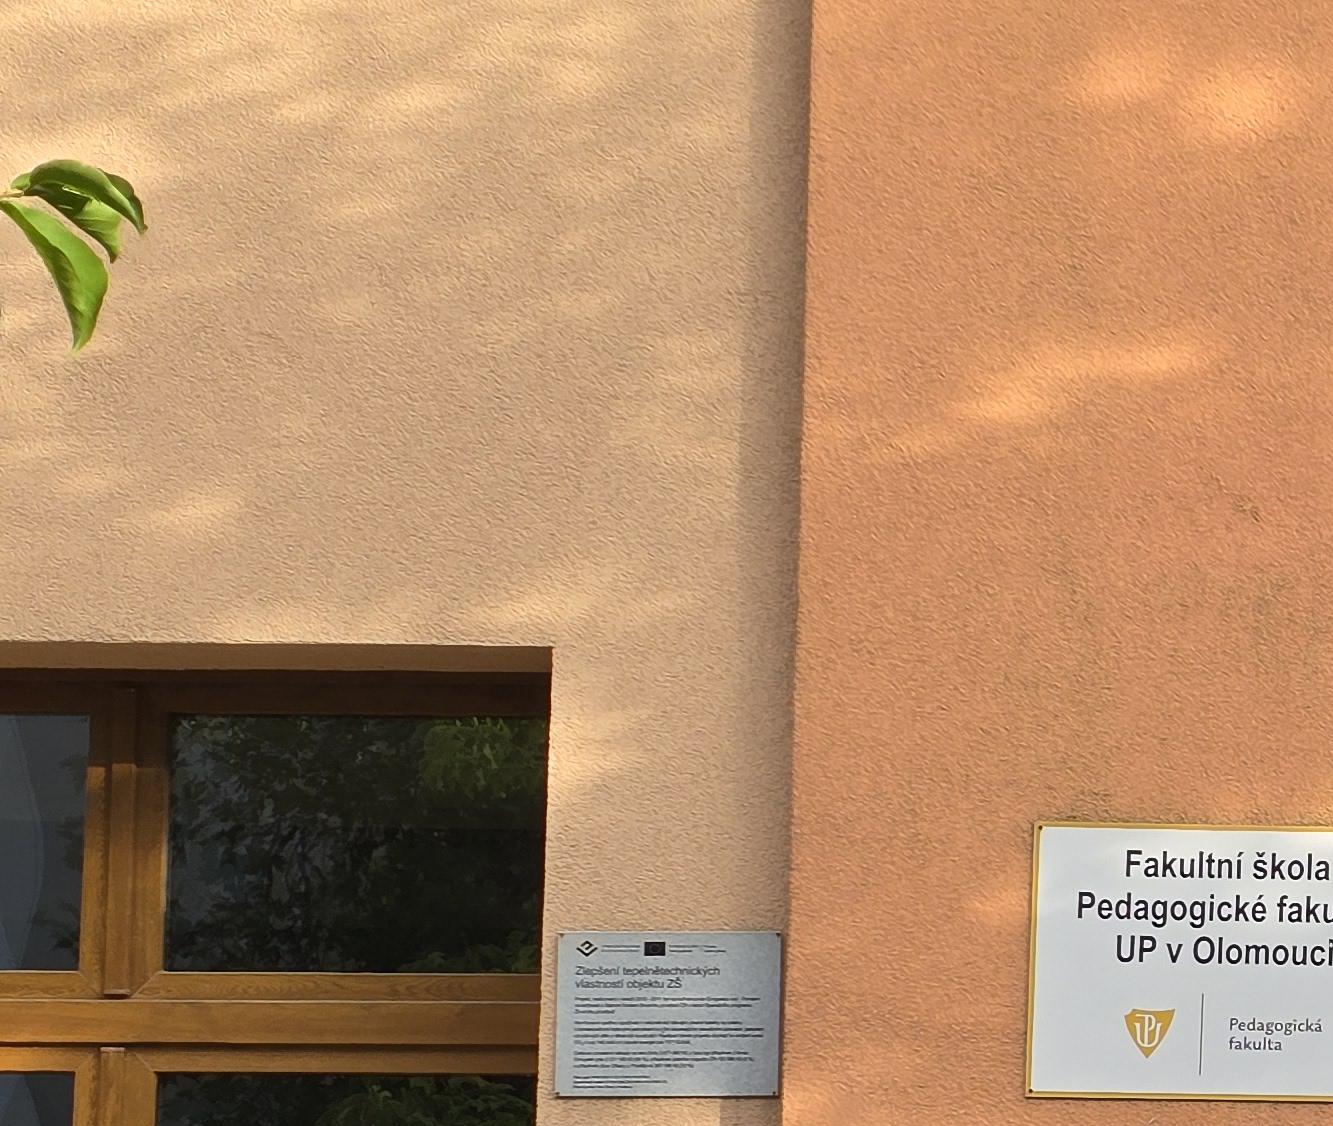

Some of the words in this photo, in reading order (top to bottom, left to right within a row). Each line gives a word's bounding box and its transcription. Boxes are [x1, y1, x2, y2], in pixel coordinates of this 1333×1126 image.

[1125, 849, 1242, 880] Fakultní
[1253, 852, 1331, 881] škola
[1077, 891, 1267, 929] Pedagogické
[1115, 935, 1157, 963] UP
[1166, 943, 1183, 964] v
[575, 965, 620, 976] Zlepšení
[575, 979, 624, 988] vlastností
[627, 979, 664, 990] objektu
[666, 977, 683, 988] ZŠ
[1229, 1018, 1323, 1034] Pedagogická
[1228, 1037, 1283, 1052] fakulta
